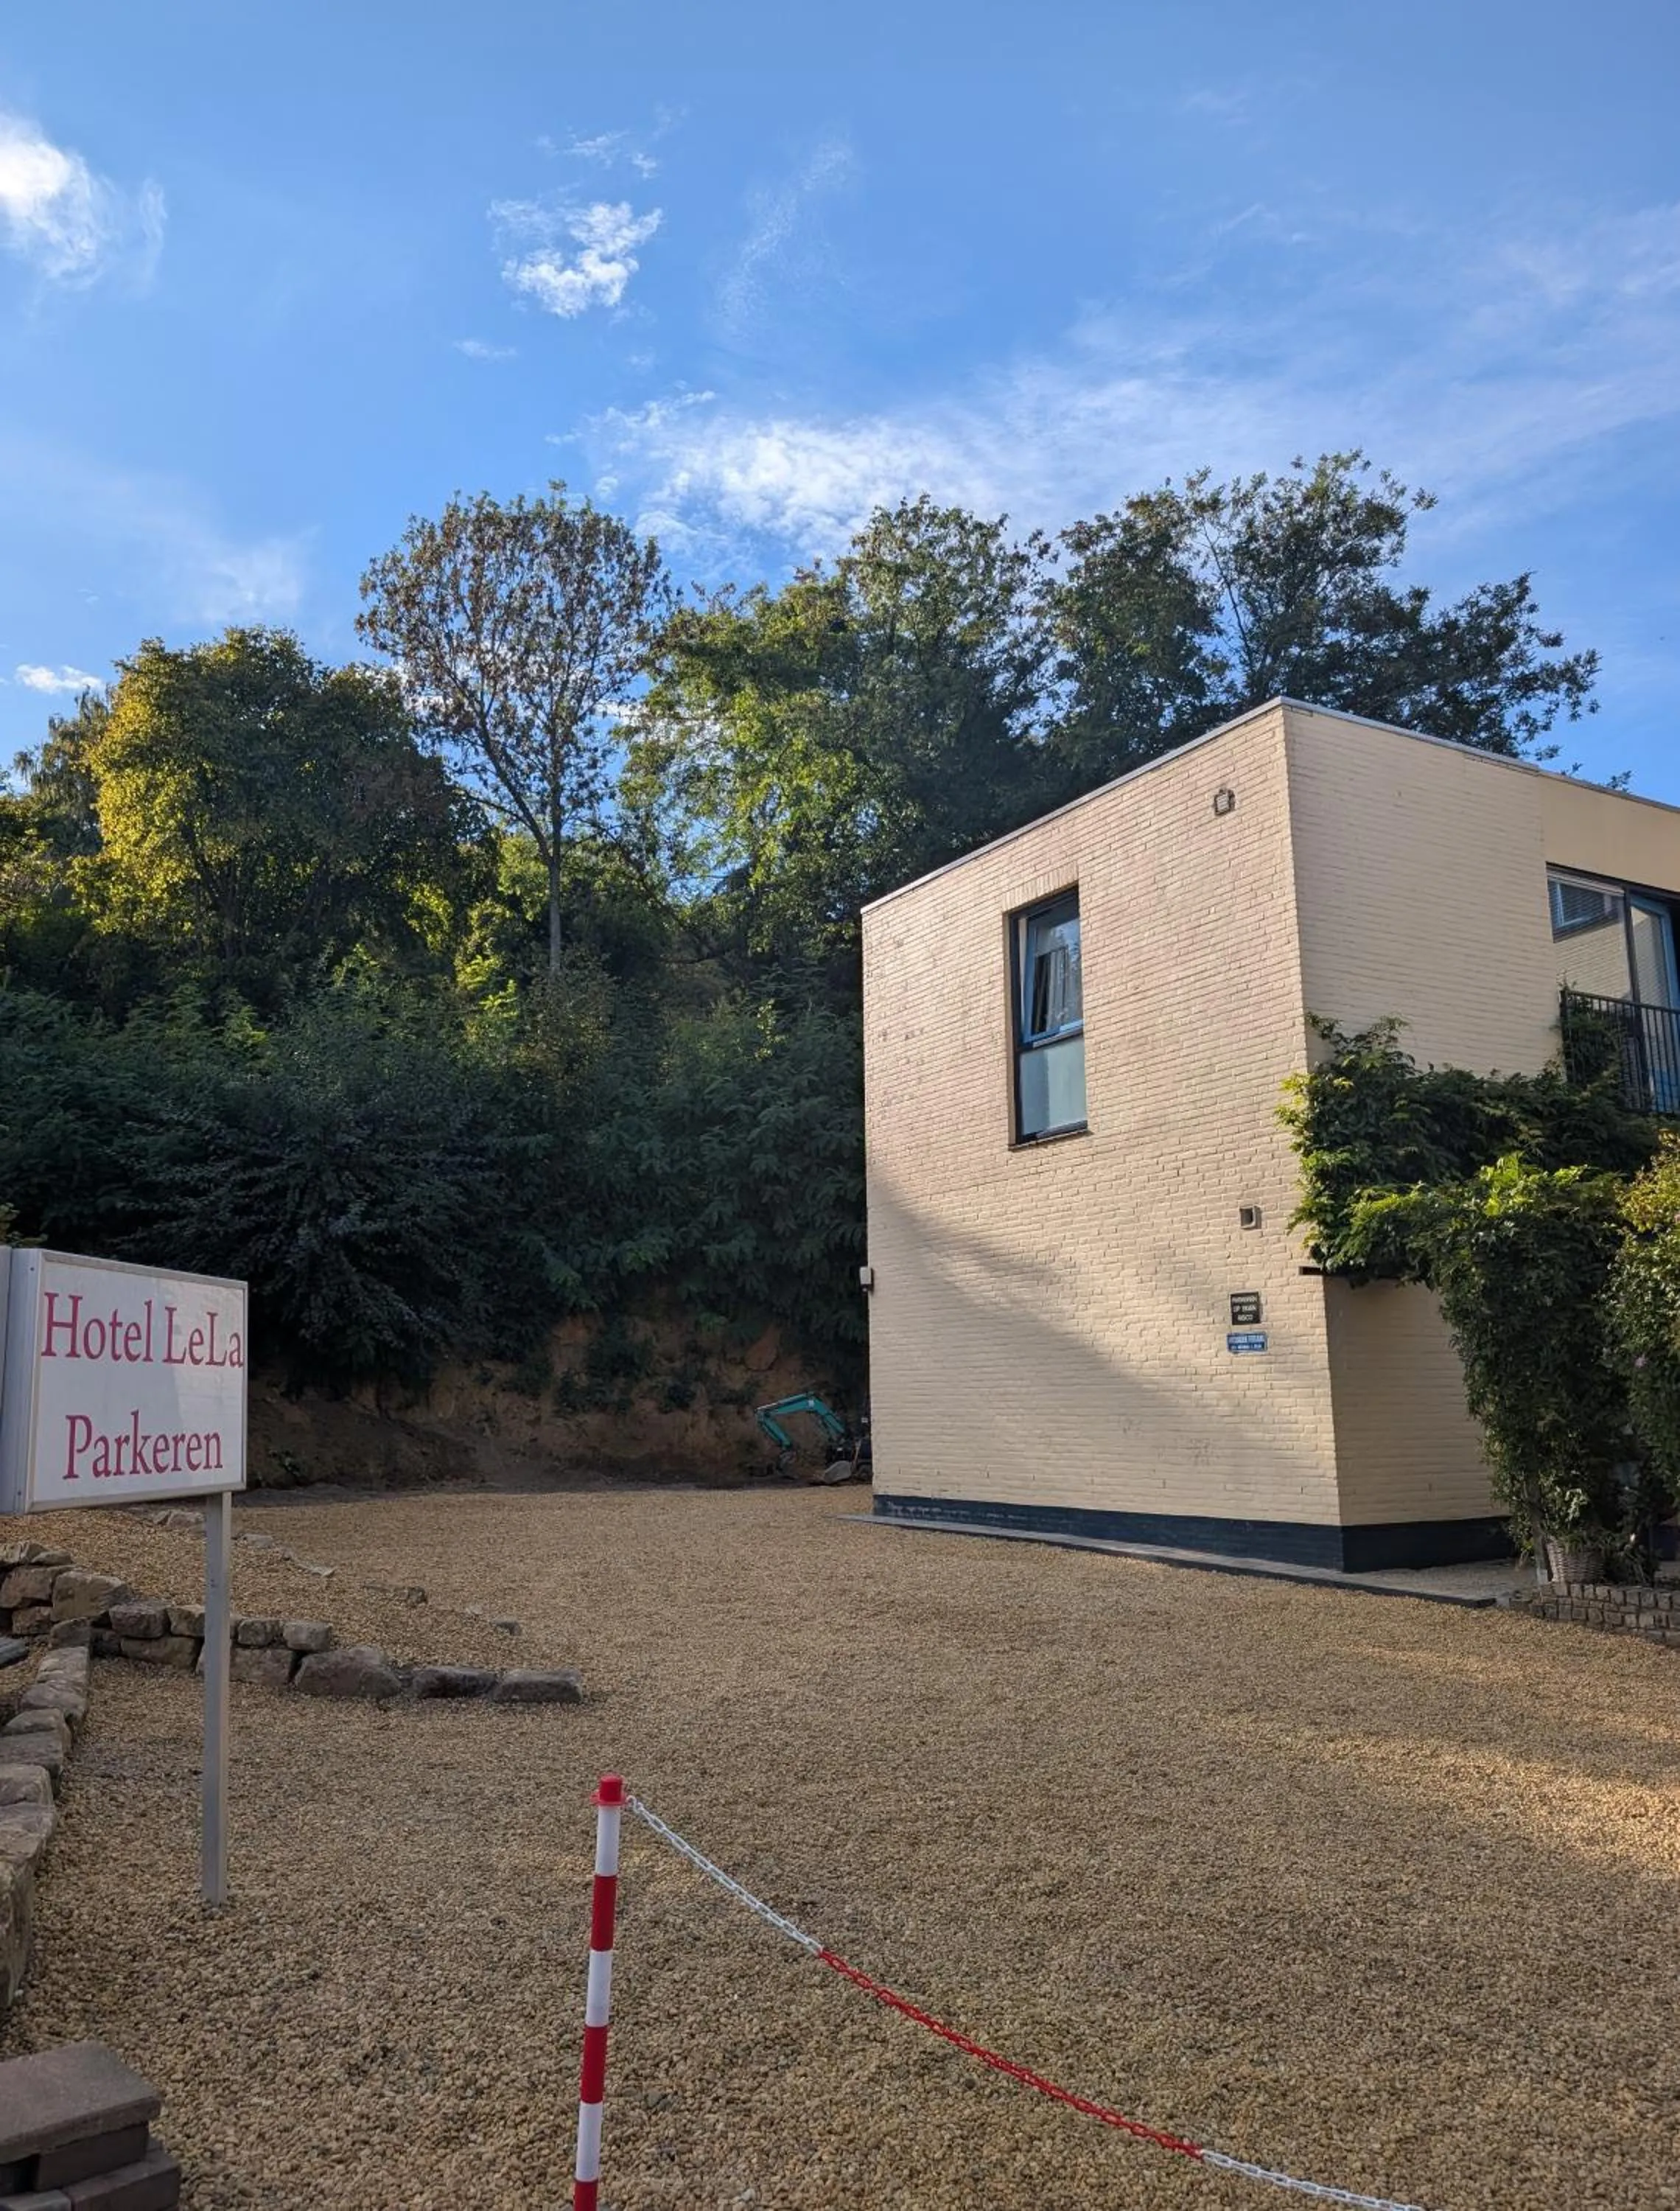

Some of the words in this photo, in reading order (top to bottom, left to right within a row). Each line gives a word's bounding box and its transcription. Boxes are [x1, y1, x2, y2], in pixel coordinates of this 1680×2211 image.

[41, 1292, 154, 1363] Hotel
[162, 1306, 243, 1369] LeLa
[62, 1409, 223, 1479] Parkeren
